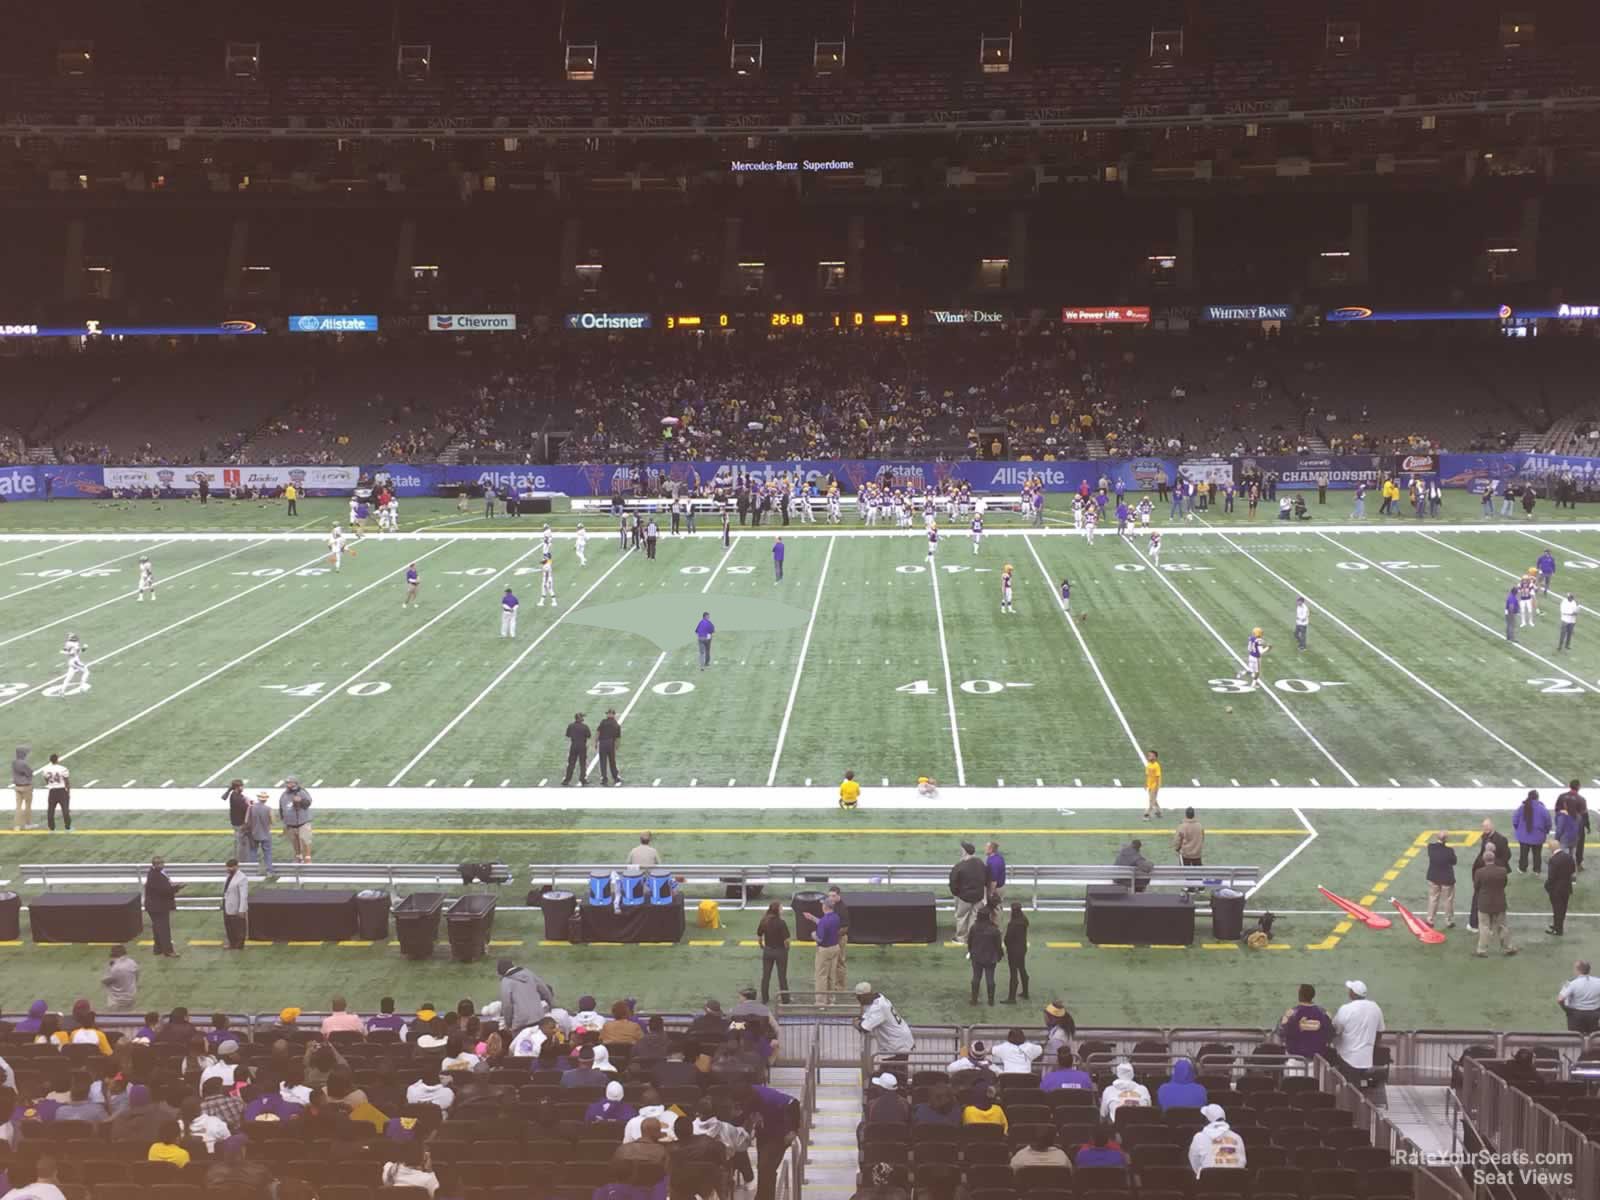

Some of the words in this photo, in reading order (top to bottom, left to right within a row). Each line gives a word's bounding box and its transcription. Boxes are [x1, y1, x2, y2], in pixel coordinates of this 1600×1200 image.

[731, 160, 798, 171] Mercedes-Benz
[803, 159, 854, 171] Superdome
[933, 311, 965, 324] Winn
[974, 310, 1003, 322] Dixie
[1065, 311, 1078, 320] We
[1079, 311, 1104, 320] Power
[1208, 306, 1255, 319] WHITNEY
[1258, 305, 1288, 318] BANK
[319, 318, 366, 331] Allstate
[457, 316, 508, 328] Chevron
[581, 313, 644, 329] Ochsner
[666, 317, 675, 329] 3
[719, 314, 728, 327] 0
[900, 314, 909, 327] 3
[477, 471, 546, 490] Allstate
[991, 467, 1065, 485] Allstate
